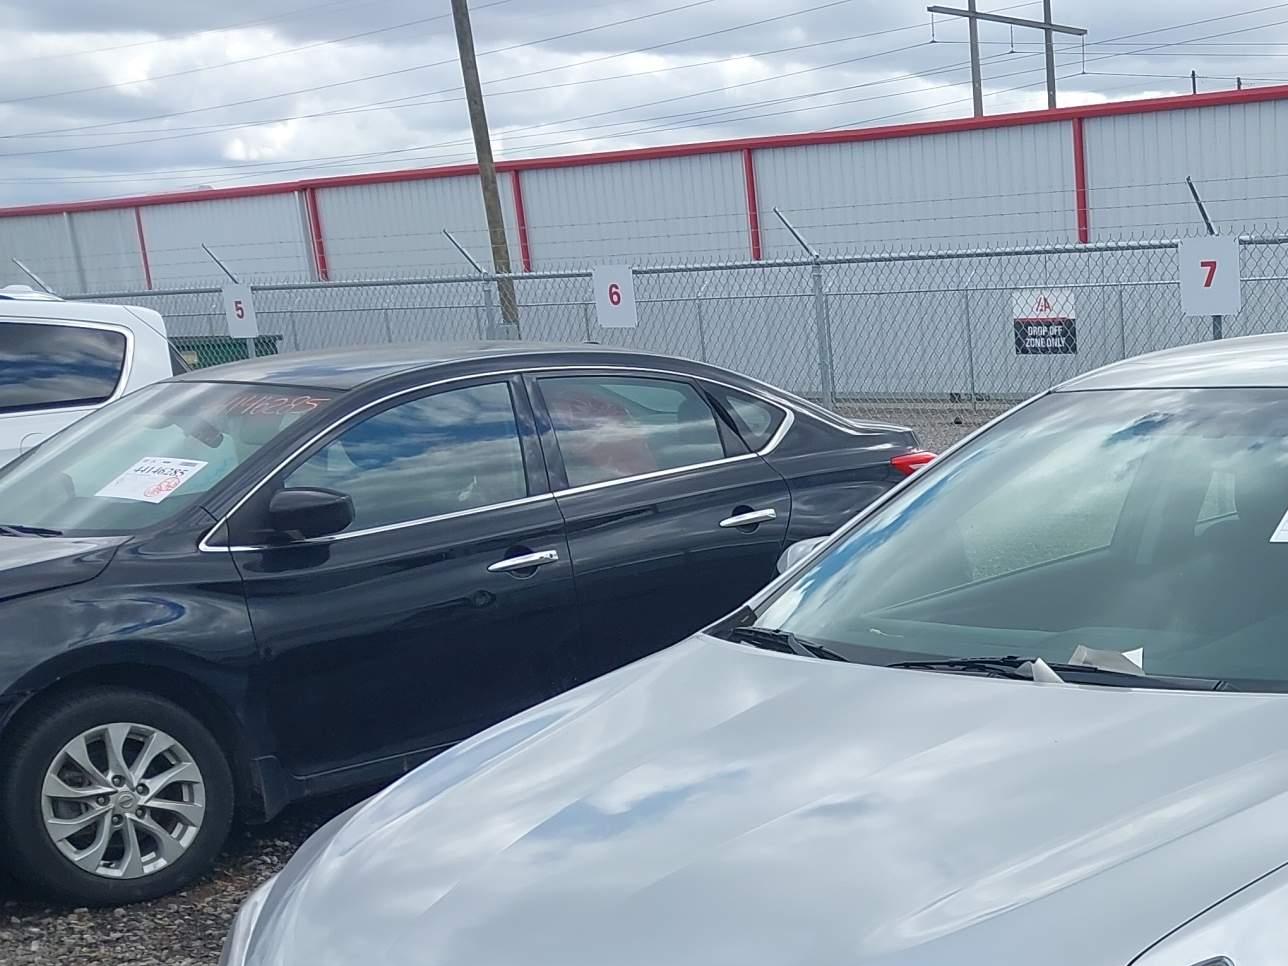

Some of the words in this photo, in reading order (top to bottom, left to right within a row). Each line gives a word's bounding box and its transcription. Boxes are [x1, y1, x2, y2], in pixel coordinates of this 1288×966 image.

[1200, 260, 1217, 288] 7
[608, 283, 621, 306] 6
[234, 300, 245, 319] 5
[1027, 326, 1048, 336] DROP
[1049, 325, 1063, 336] OFF
[1025, 337, 1046, 348] ZONE
[1046, 337, 1066, 347] ONLY
